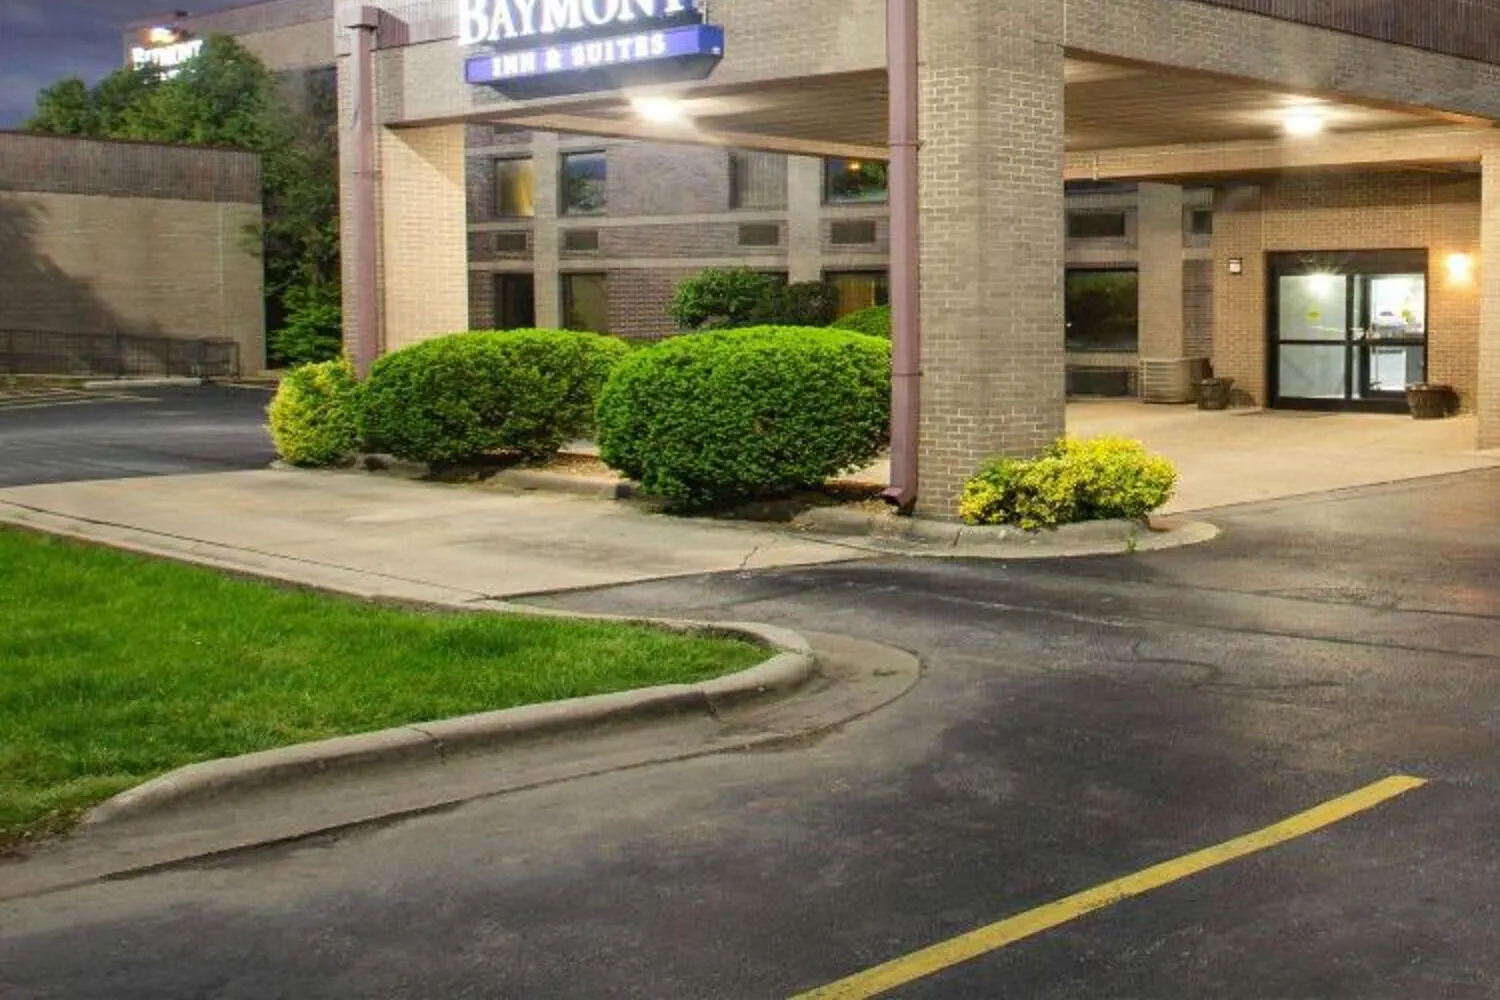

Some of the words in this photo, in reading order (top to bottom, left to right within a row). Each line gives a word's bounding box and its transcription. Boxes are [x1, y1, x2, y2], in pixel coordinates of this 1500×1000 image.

[491, 52, 537, 77] INN
[544, 47, 562, 69] &
[570, 33, 667, 66] SUITES
